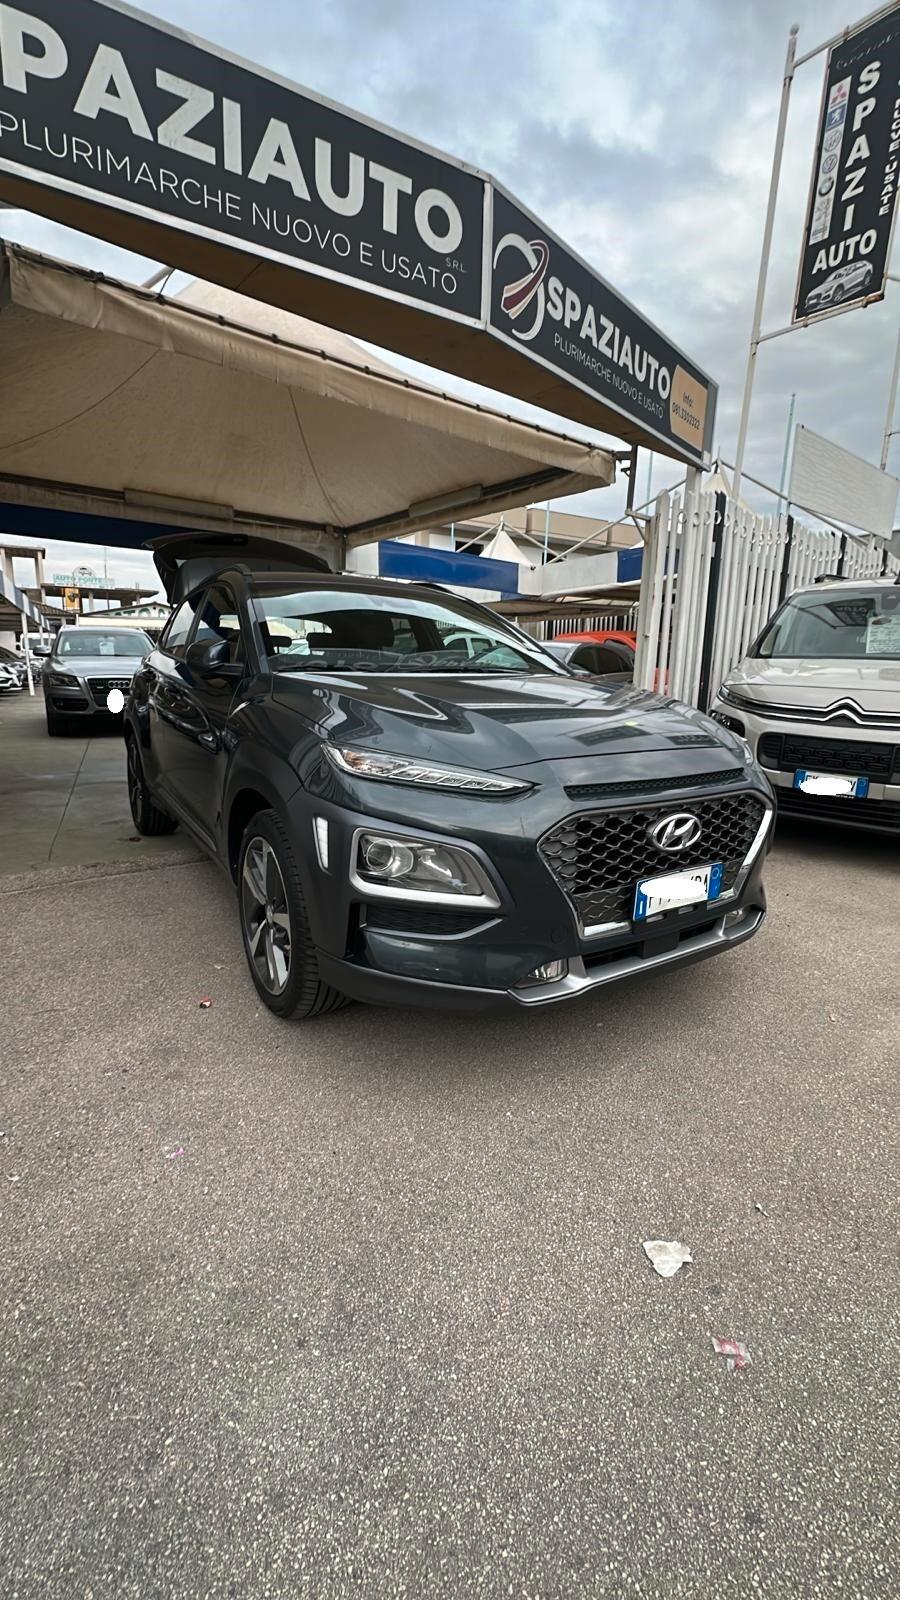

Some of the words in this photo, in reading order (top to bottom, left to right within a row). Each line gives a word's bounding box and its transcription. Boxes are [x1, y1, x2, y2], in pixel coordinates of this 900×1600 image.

[878, 160, 899, 216] USATE
[252, 202, 351, 257] NUOVO
[359, 242, 373, 264] E
[381, 255, 457, 294] USATO
[811, 228, 877, 275] AUTO
[546, 275, 671, 400] SPAZIAUTO
[554, 332, 612, 384] PLURIMARCHE
[612, 373, 638, 401] NUOVO
[638, 392, 643, 405] E
[643, 394, 664, 419] USATO
